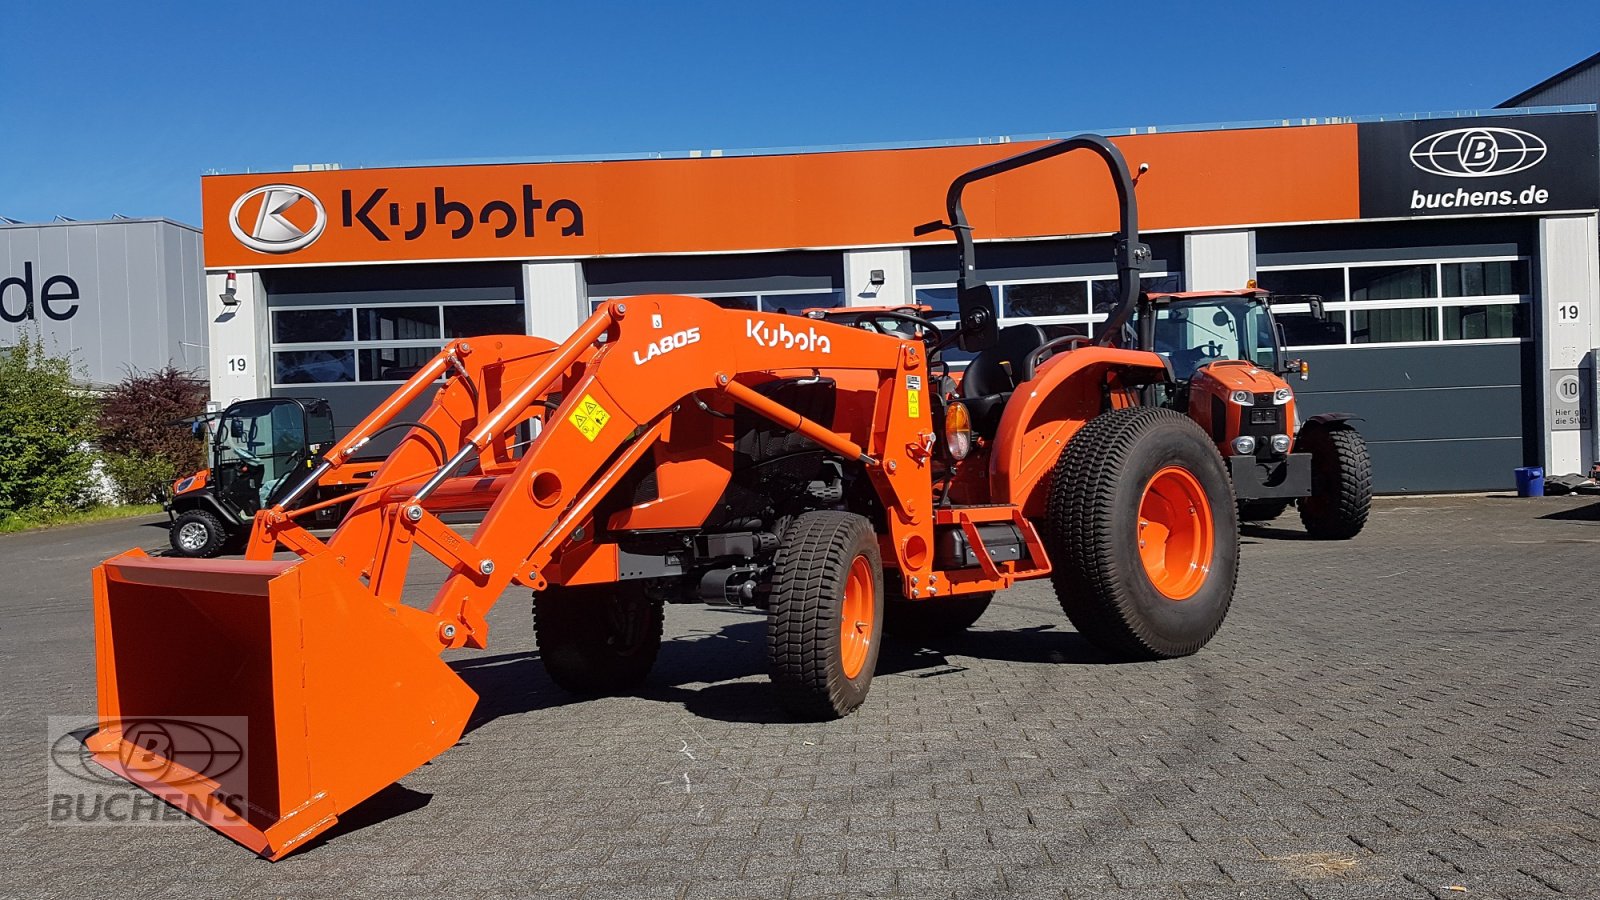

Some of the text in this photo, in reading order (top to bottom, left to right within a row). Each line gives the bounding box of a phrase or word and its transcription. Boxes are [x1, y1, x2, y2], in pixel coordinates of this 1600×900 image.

[1410, 185, 1549, 209] buchens.de
[341, 184, 584, 241] Kubota
[0, 261, 80, 323] de
[1559, 305, 1578, 319] 19
[633, 327, 701, 366] LA805
[746, 318, 831, 353] Kubota
[228, 358, 246, 371] 19
[1562, 382, 1577, 395] 10
